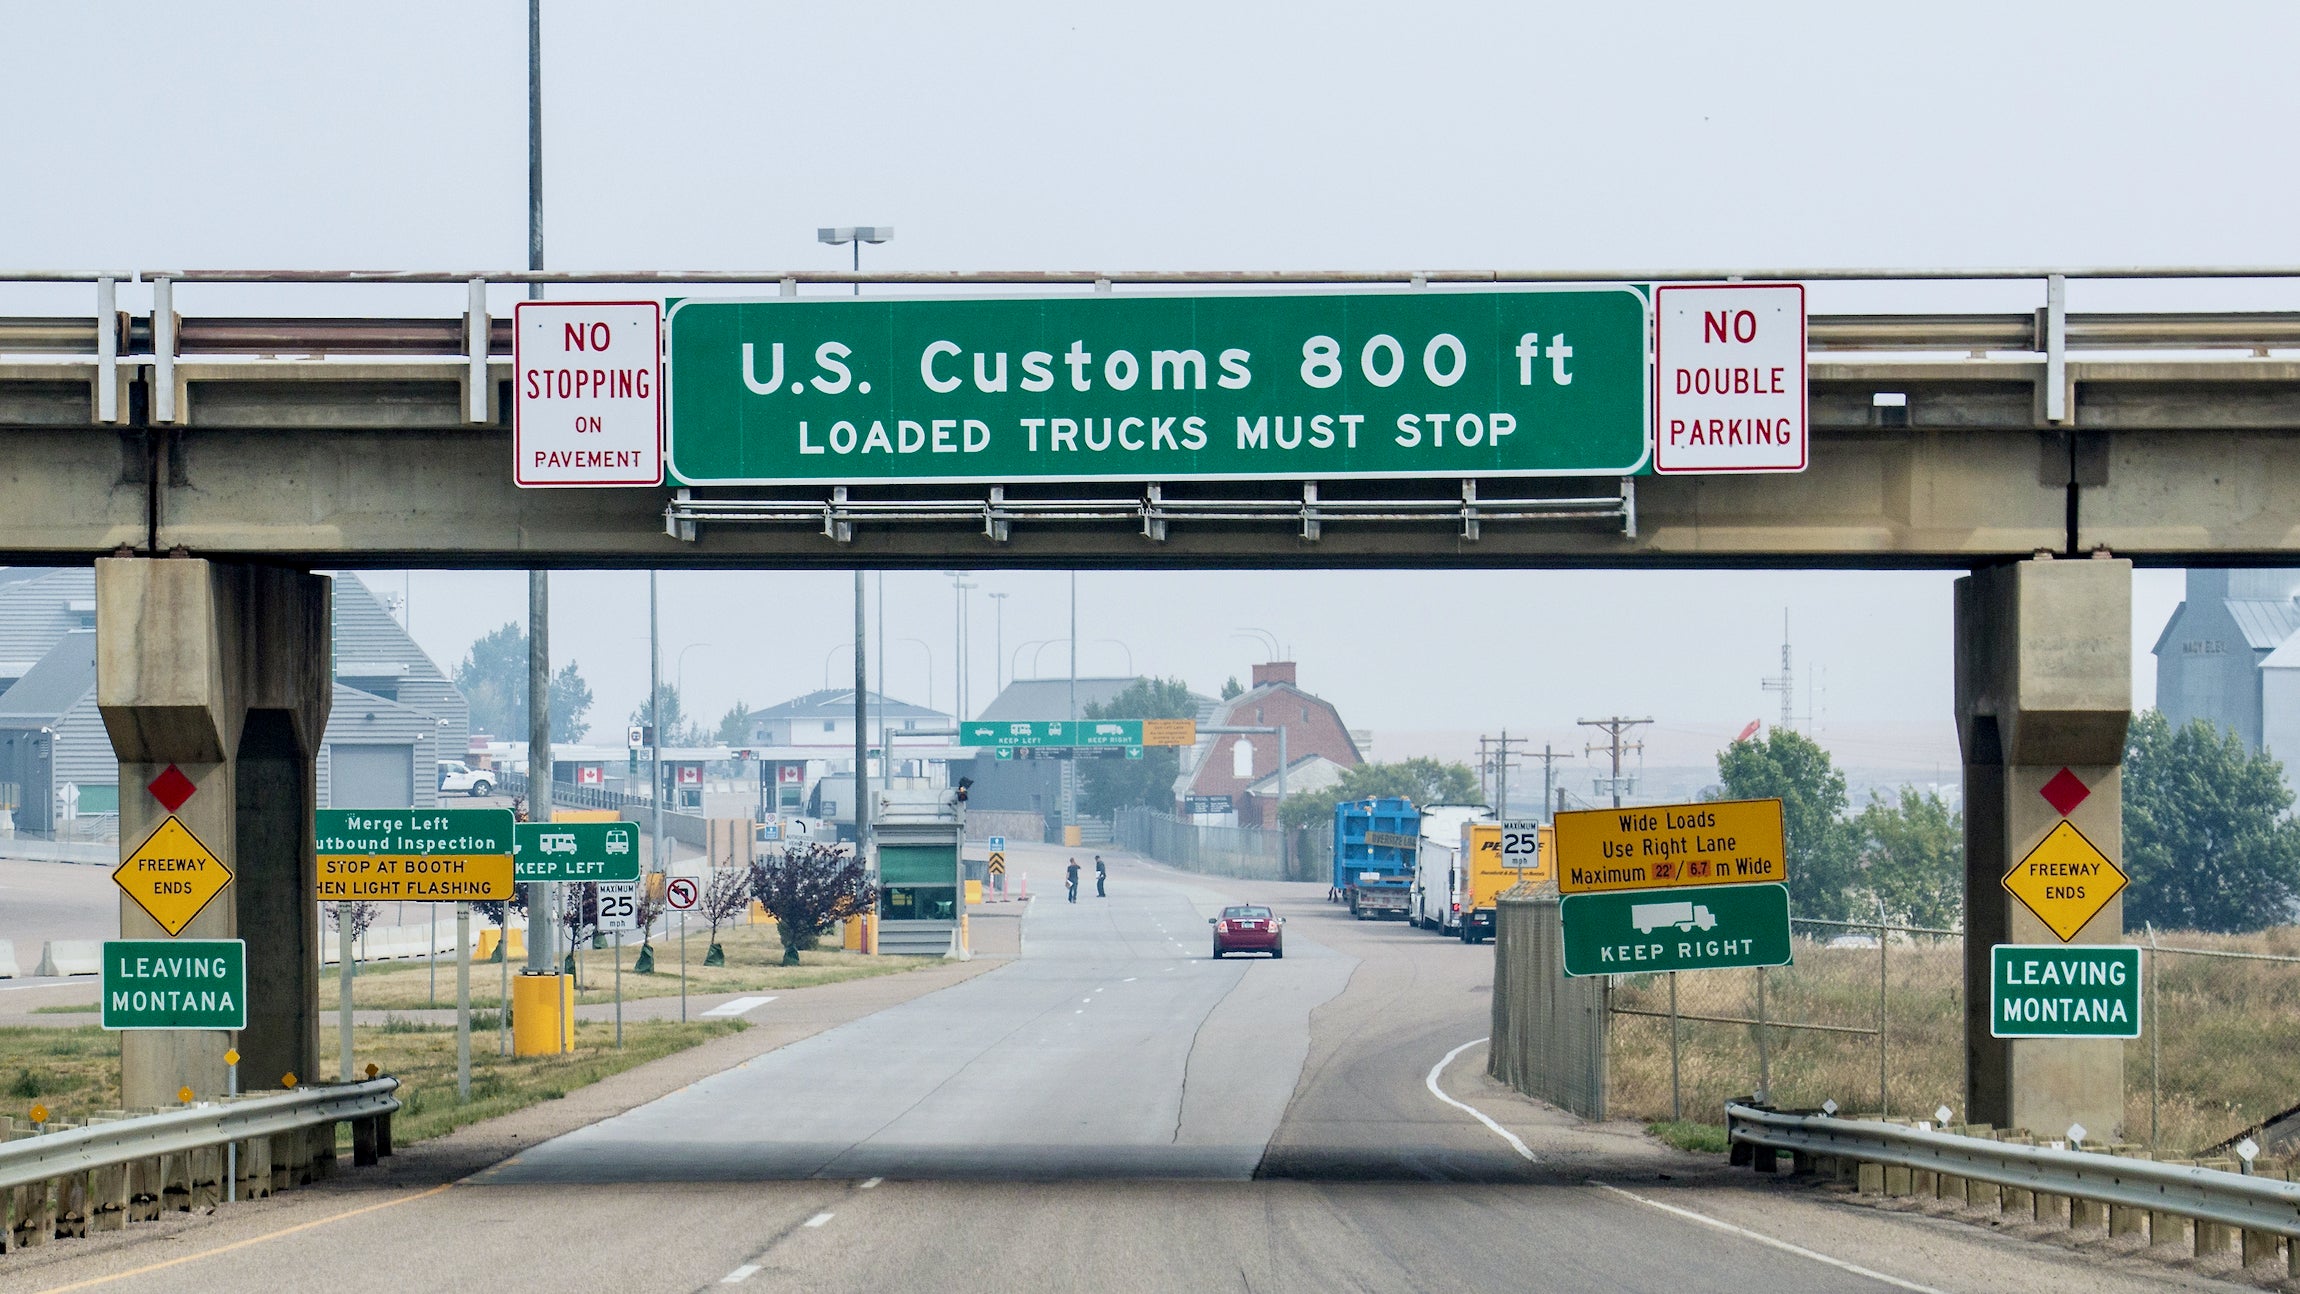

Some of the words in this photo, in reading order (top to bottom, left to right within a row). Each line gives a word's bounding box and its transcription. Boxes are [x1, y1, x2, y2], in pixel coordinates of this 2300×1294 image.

[565, 323, 611, 352] NO
[1704, 311, 1757, 344] NO
[742, 341, 872, 395] U.S.
[921, 340, 1252, 394] Customs
[1300, 334, 1467, 389] 800
[1515, 333, 1574, 386] ft
[527, 368, 649, 399] STOPPING
[1676, 367, 1786, 395] DOUBLE
[576, 416, 602, 433] ON
[800, 419, 990, 454] LOADED
[1021, 416, 1207, 452] TRUCKS
[1236, 414, 1365, 450] MUST
[1395, 413, 1517, 448] STOP
[1670, 419, 1791, 446] PARKING
[534, 450, 641, 468] PAVEMENT
[347, 817, 403, 833] Merge
[411, 817, 449, 830] Left
[1504, 821, 1536, 830] MAXIMUM
[1619, 814, 1657, 832] Wide
[1667, 811, 1715, 830] Loads
[316, 837, 389, 850] utbound
[398, 836, 496, 853] Inspection
[1504, 834, 1536, 854] 25
[1603, 841, 1633, 858] Use
[1643, 837, 1687, 860] Right
[1697, 835, 1736, 852] Lane
[139, 859, 206, 871] FREEWAY
[327, 861, 370, 873] STOP
[377, 861, 397, 873] AT
[405, 861, 465, 873] BOOTH
[515, 862, 557, 874] KEEP
[566, 862, 605, 874] LEFT
[1572, 866, 1645, 885] Maximum
[1690, 862, 1708, 875] 6.7
[1716, 863, 1730, 877] m
[1736, 858, 1772, 876] Wide
[2030, 863, 2100, 876] FREEWAY
[154, 882, 192, 894] ENDS
[316, 881, 346, 894] HEN
[353, 882, 400, 894] LIGHT
[407, 882, 491, 894] FLASHING
[600, 884, 633, 893] MAXIMUM
[2046, 886, 2085, 899] ENDS
[601, 896, 633, 917] 25
[1601, 944, 1663, 962] KEEP
[1678, 939, 1753, 958] RIGHT
[121, 957, 227, 978] LEAVING
[2007, 961, 2126, 986] LEAVING
[112, 991, 235, 1012] MONTANA
[2003, 997, 2128, 1023] MONTANA
